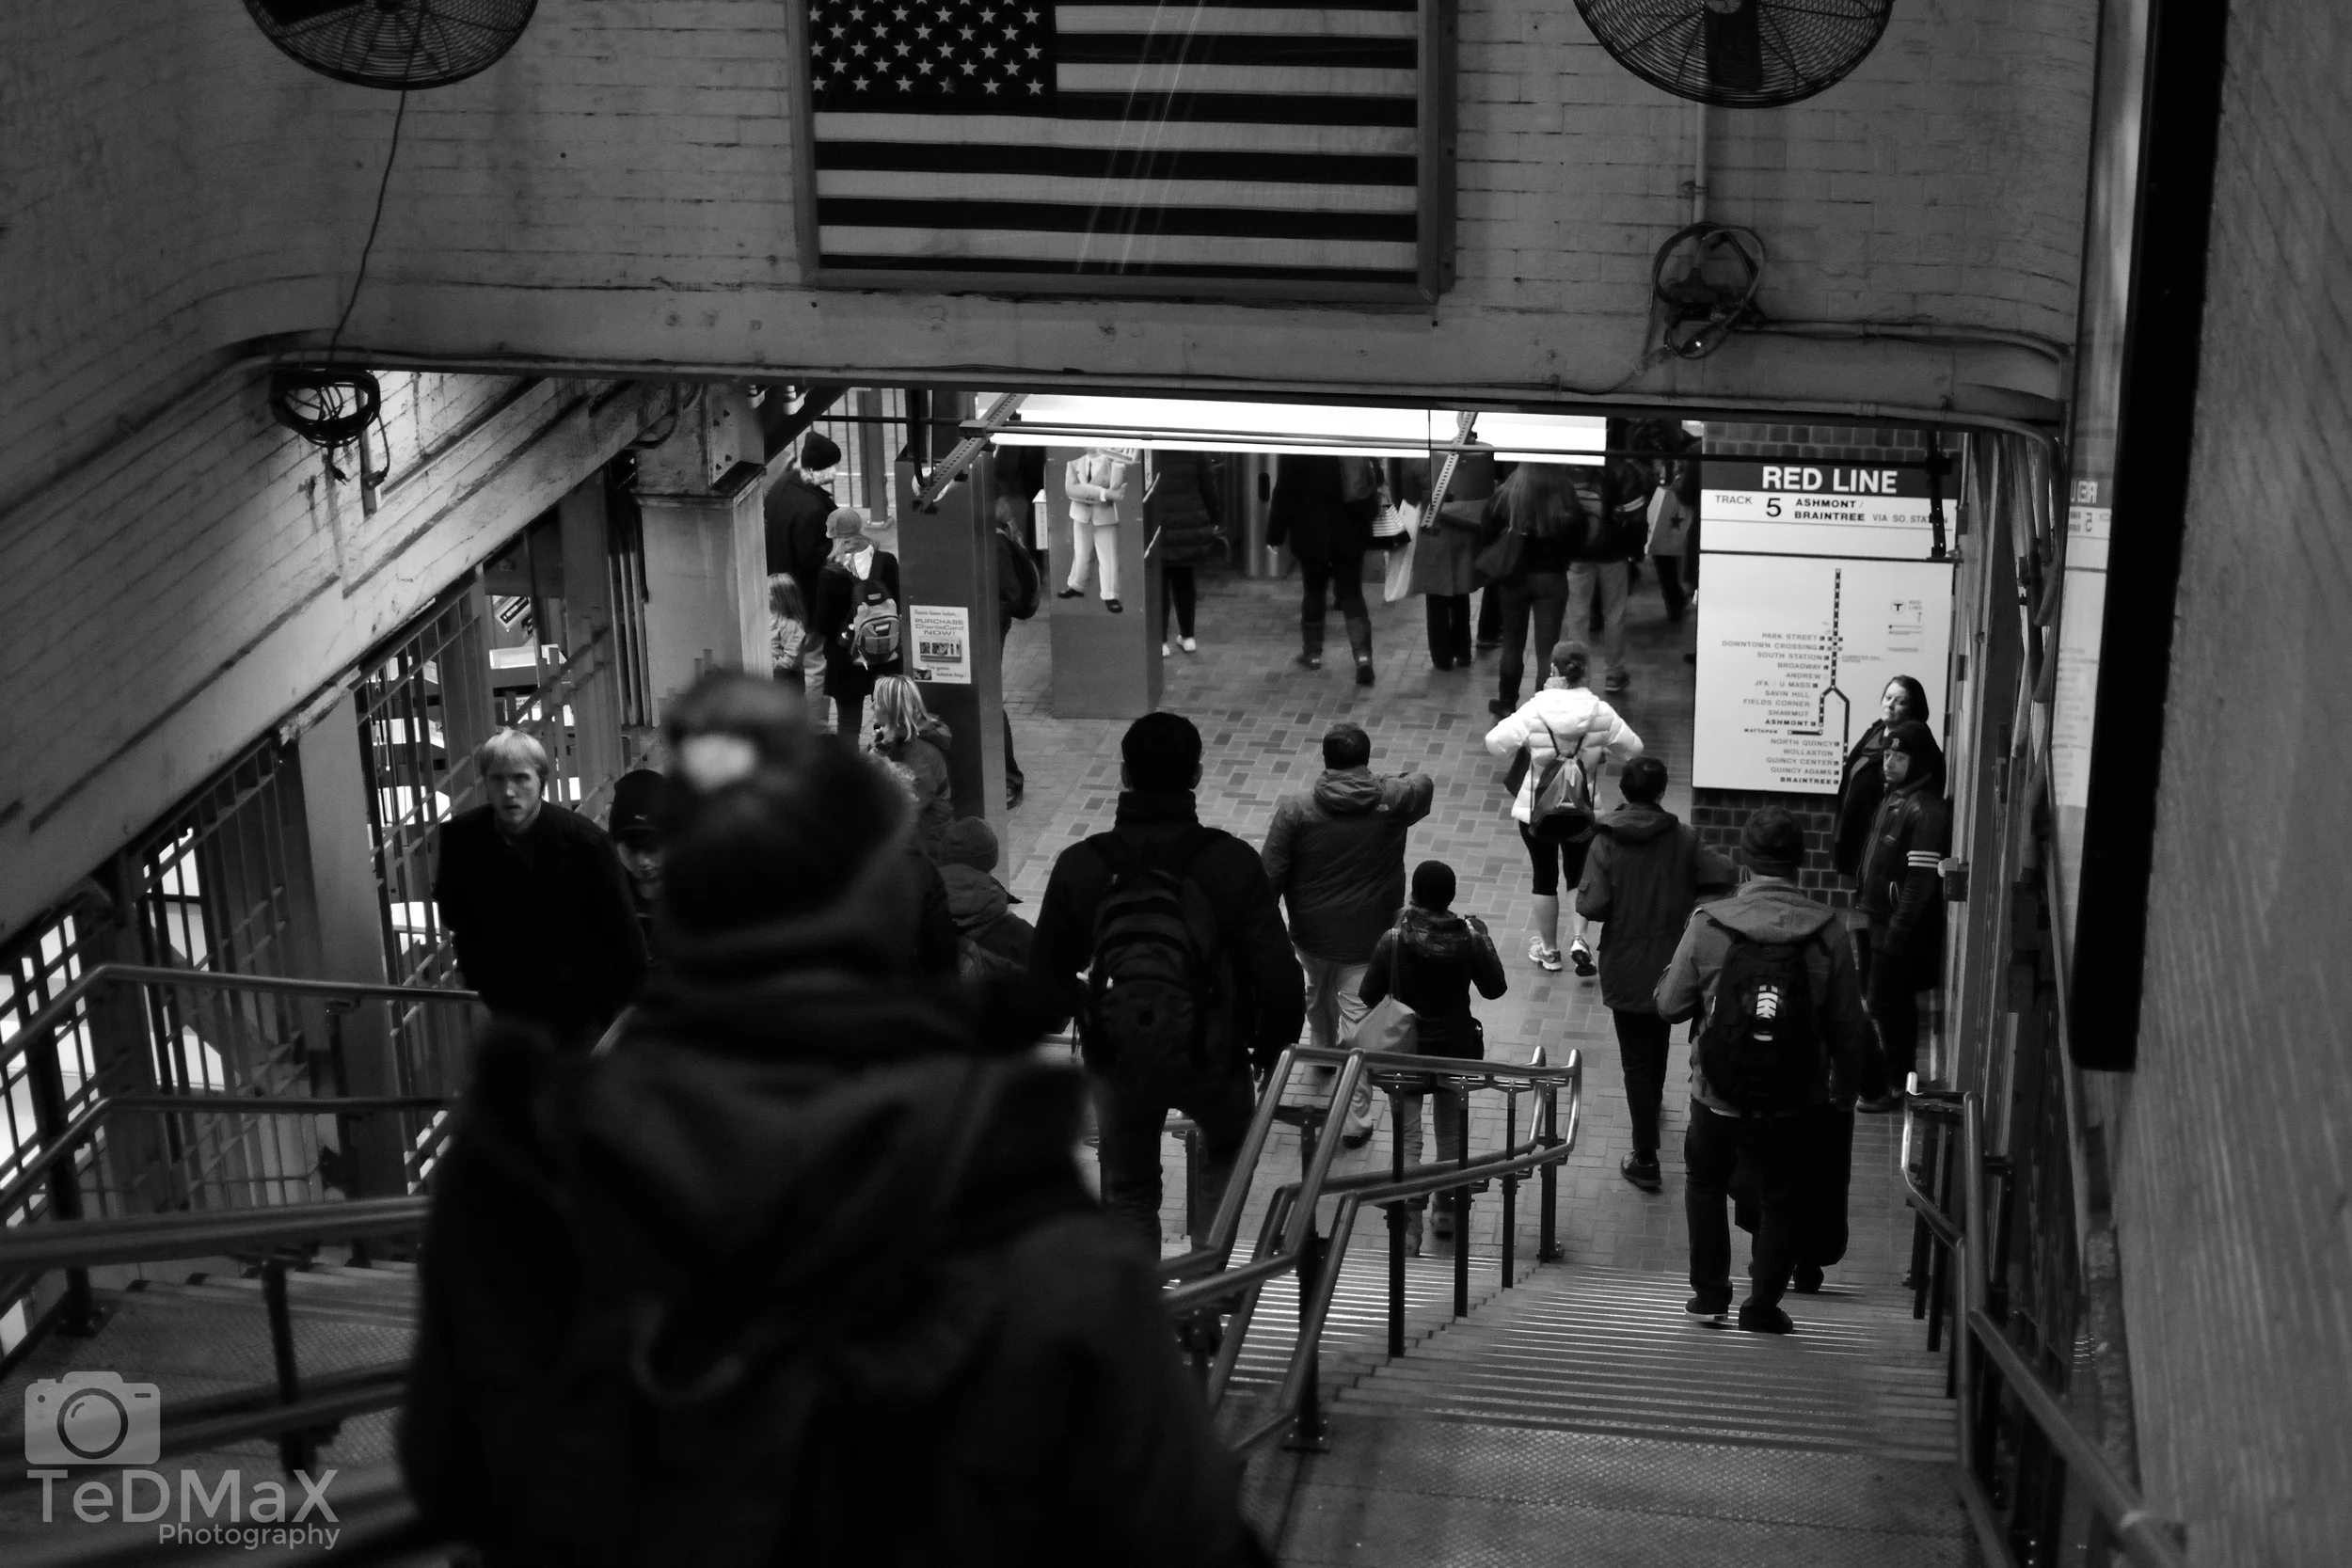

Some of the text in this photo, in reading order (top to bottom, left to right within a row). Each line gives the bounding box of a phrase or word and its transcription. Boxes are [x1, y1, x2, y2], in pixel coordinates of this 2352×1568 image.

[1762, 466, 1898, 494] RED LINE
[1715, 495, 1753, 505] TRACK
[1795, 499, 1856, 509] ASHMONT
[1765, 498, 1782, 517] 5
[1794, 511, 1865, 521] BRAINTREE
[1872, 514, 1888, 522] VIA
